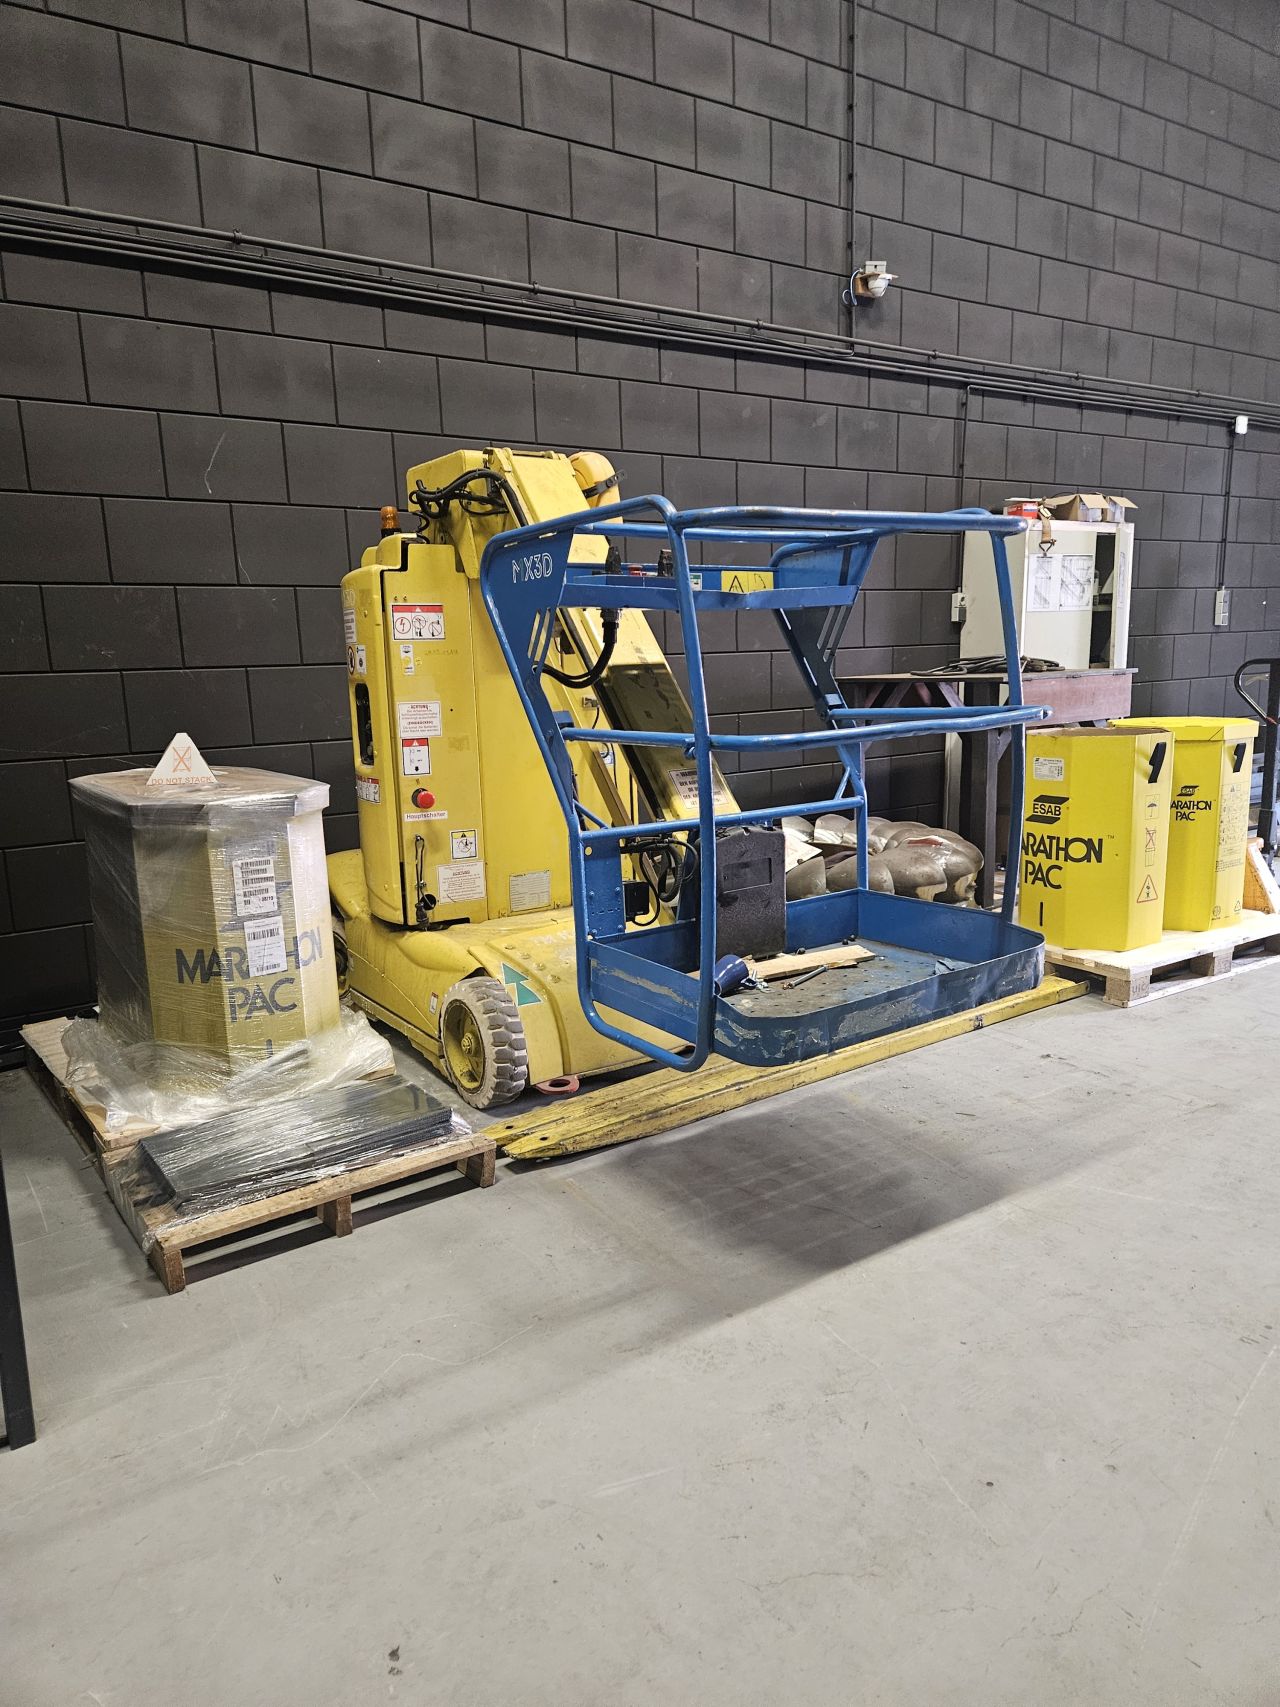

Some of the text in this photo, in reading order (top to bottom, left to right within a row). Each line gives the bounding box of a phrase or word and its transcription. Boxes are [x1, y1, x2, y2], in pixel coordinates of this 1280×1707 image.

[511, 552, 553, 583] MX3D
[1033, 803, 1061, 816] ESAB
[1170, 800, 1212, 810] ARATHON
[1175, 811, 1196, 821] PAC
[1024, 859, 1063, 890] PAC
[227, 977, 298, 1022] PAC
